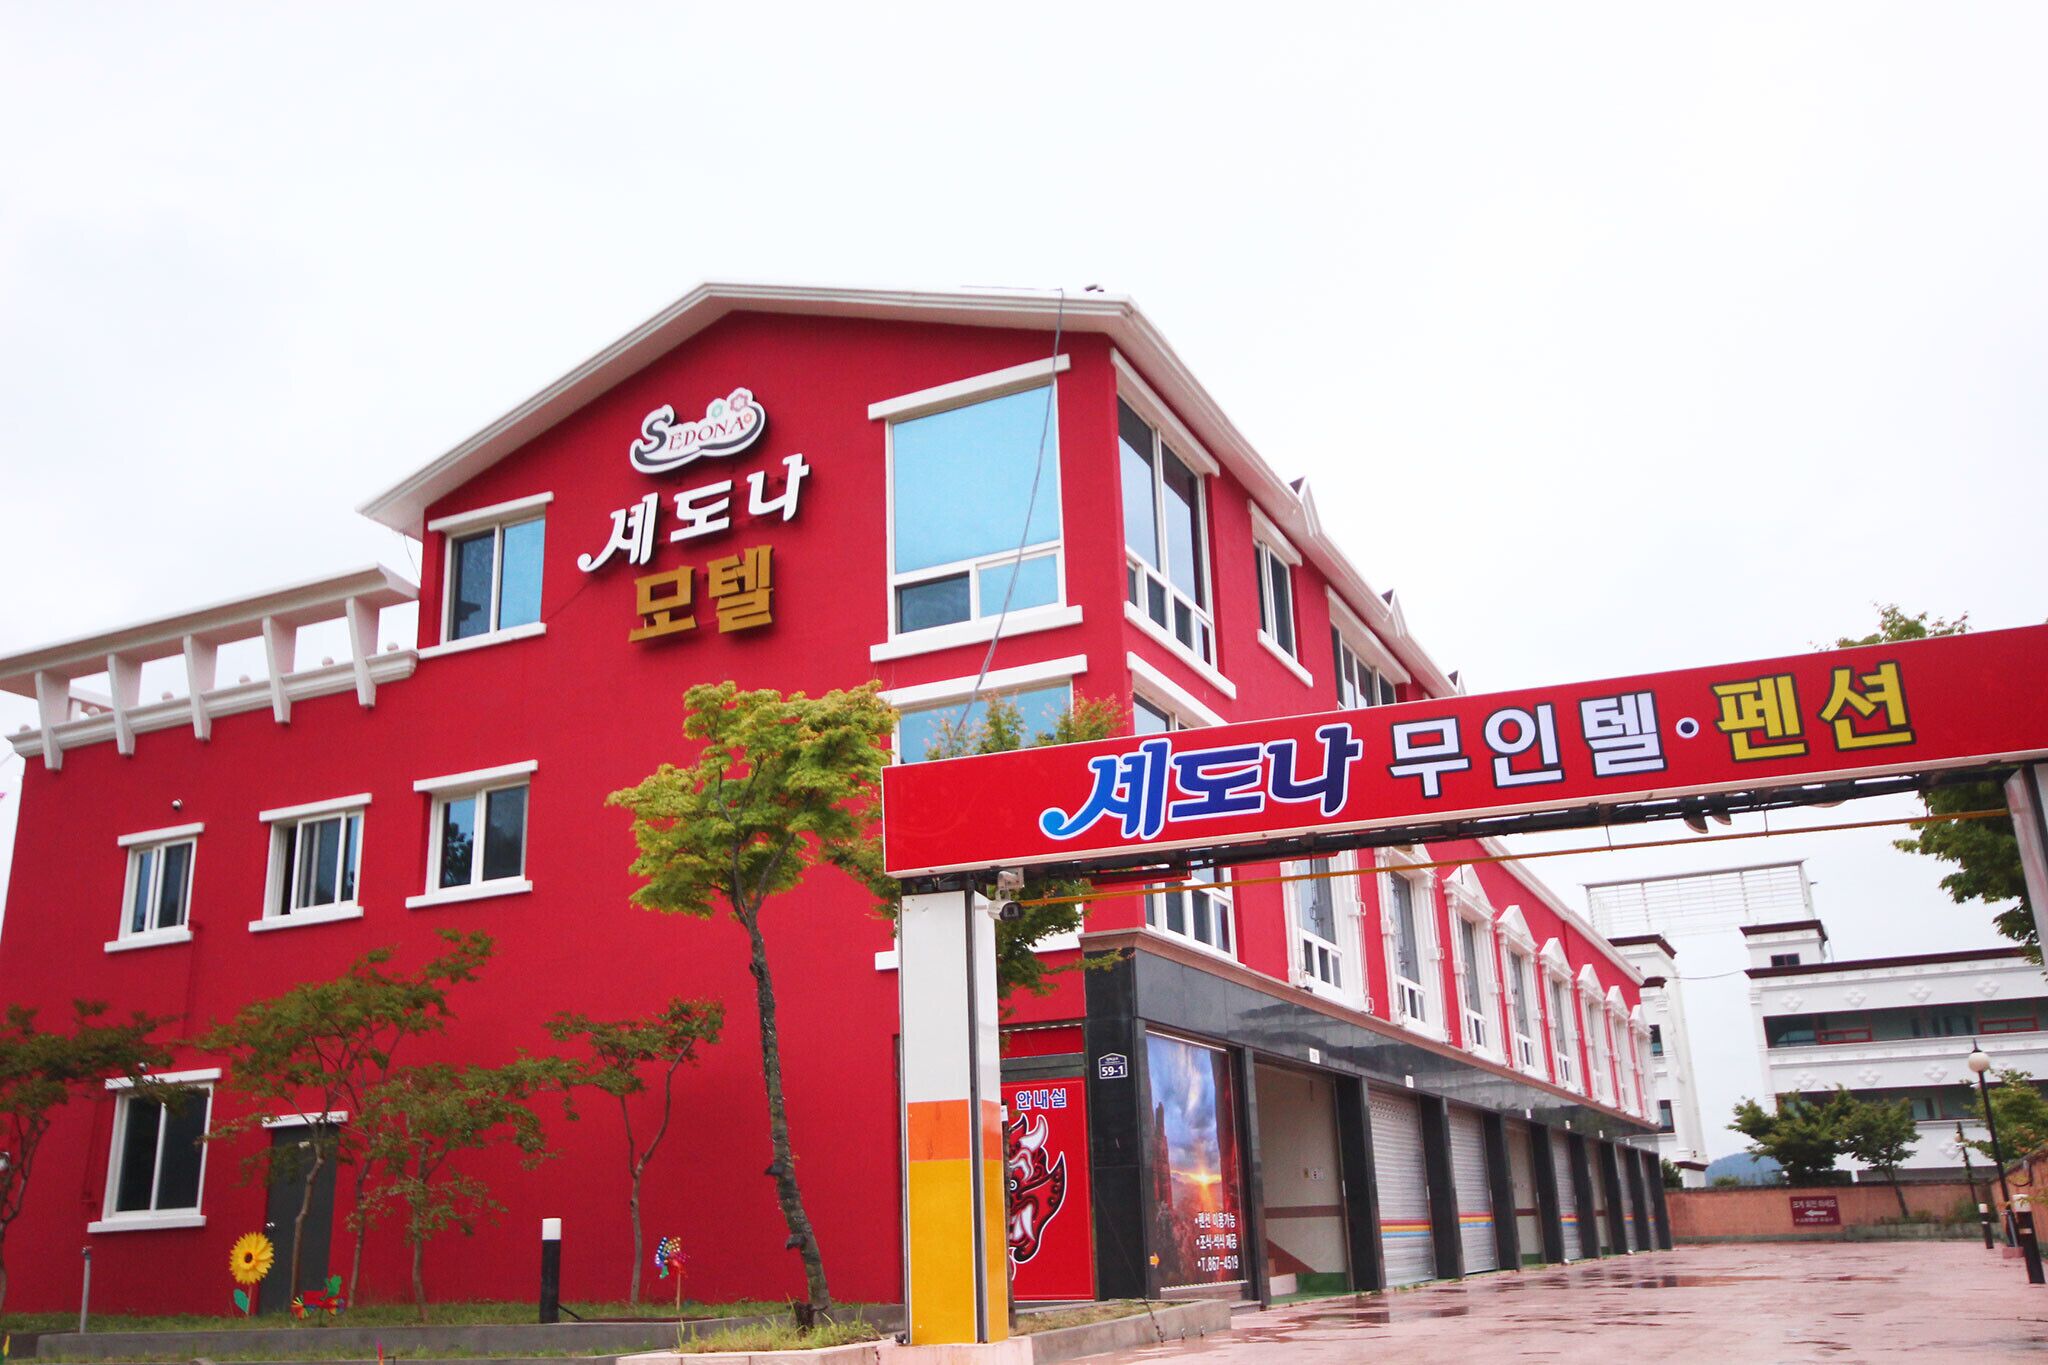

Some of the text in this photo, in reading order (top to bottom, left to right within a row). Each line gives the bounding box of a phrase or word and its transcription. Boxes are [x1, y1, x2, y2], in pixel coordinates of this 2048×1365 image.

[633, 413, 746, 465] SEDONA
[577, 453, 810, 573] 세도나
[628, 544, 774, 642] 모텔
[1039, 722, 1364, 840] 세도나
[1015, 1087, 1067, 1110] 안내실
[1101, 1065, 1124, 1077] 59-1
